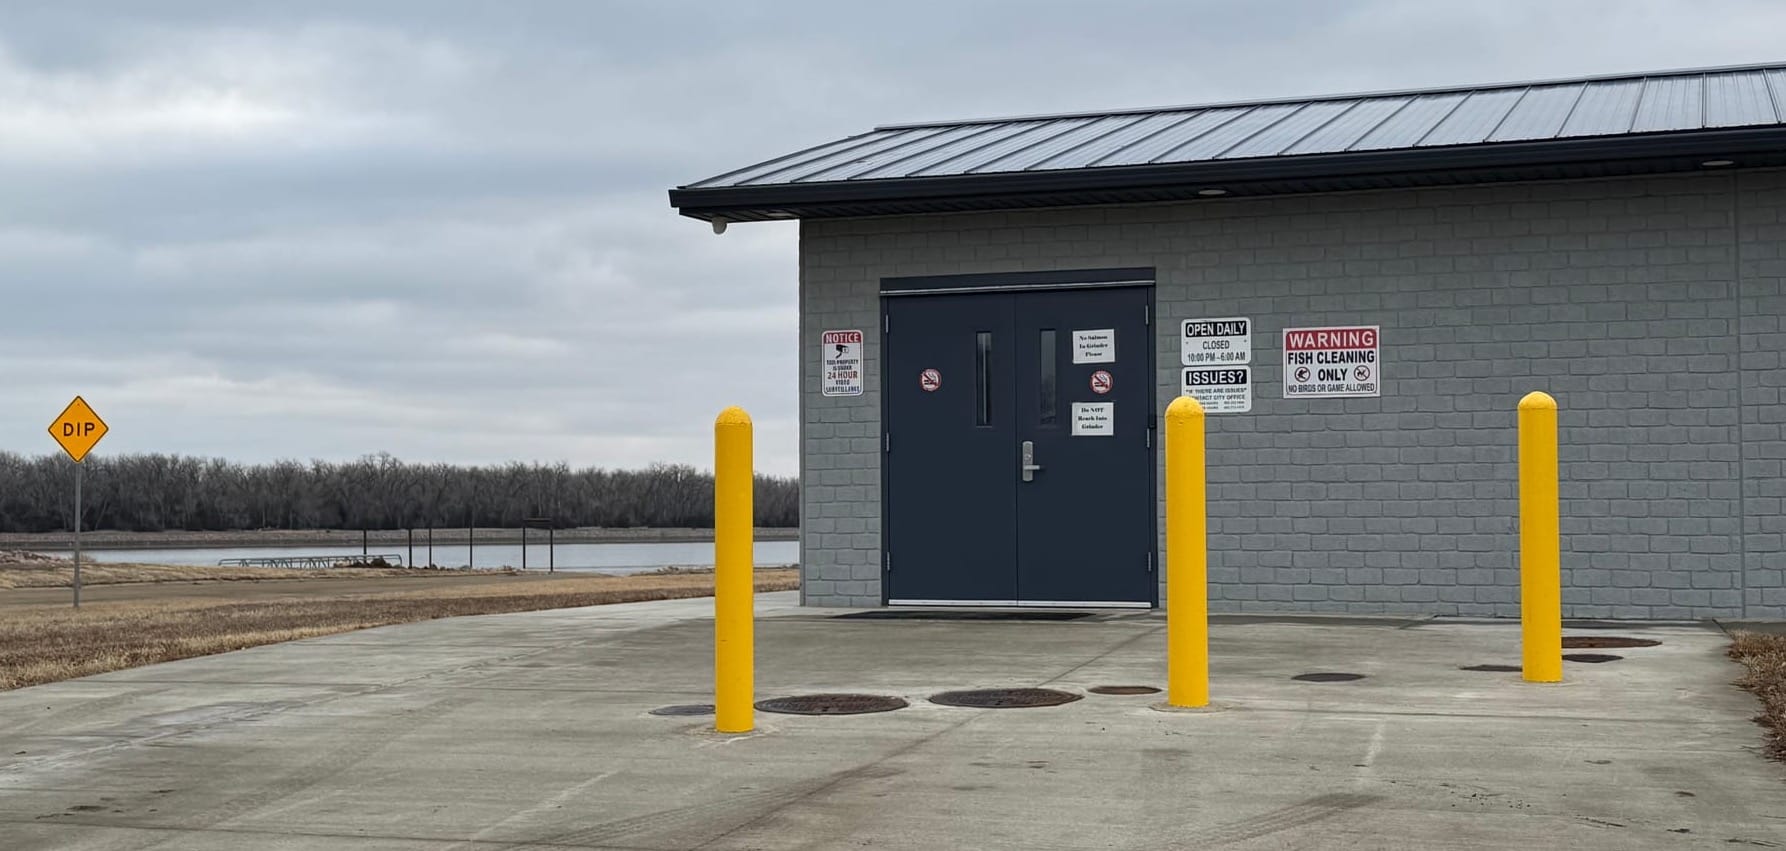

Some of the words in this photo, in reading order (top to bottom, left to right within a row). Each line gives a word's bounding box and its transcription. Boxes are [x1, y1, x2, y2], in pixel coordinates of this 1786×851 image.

[1186, 324, 1214, 336] OPEN
[1216, 322, 1245, 334] DAILY
[826, 333, 859, 344] NOTICE
[1202, 340, 1230, 350] CLOSED
[1289, 332, 1374, 348] WARNING
[1188, 353, 1204, 362] 10:00
[1206, 352, 1215, 361] PM
[1235, 352, 1246, 360] AM
[1288, 352, 1313, 364] FISH
[1317, 350, 1374, 364] CLEANING
[1188, 371, 1244, 384] ISSUES?
[1318, 368, 1348, 381] ONLY
[1317, 384, 1326, 392] OR
[1327, 384, 1344, 392] GAME
[1345, 383, 1374, 392] ALLOWED
[64, 422, 95, 437] DIP
